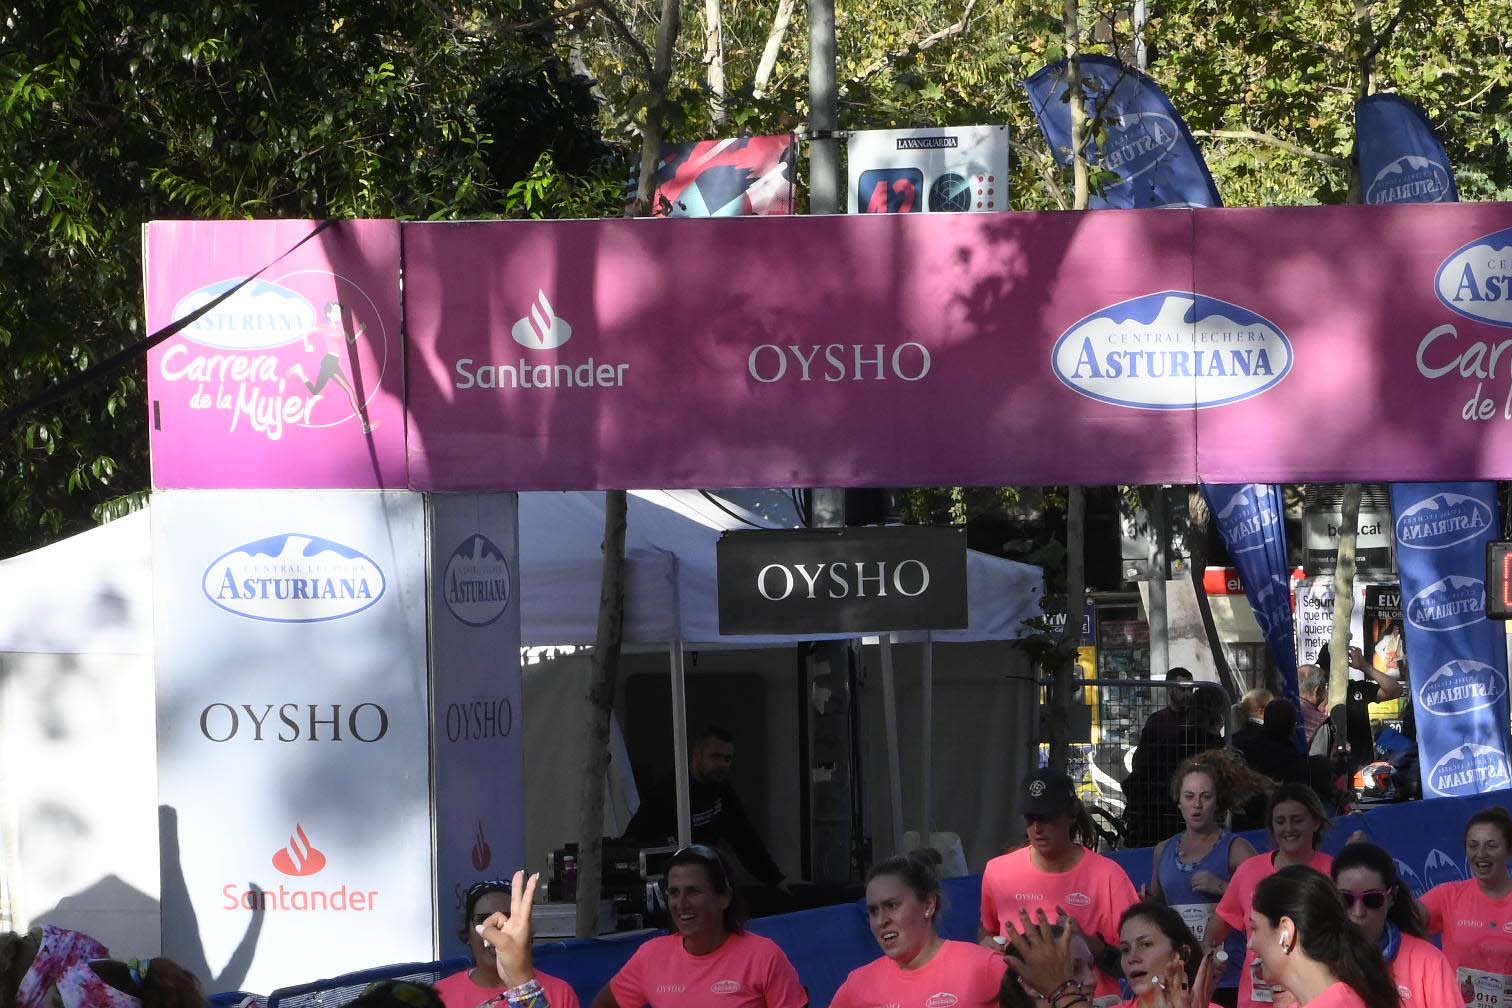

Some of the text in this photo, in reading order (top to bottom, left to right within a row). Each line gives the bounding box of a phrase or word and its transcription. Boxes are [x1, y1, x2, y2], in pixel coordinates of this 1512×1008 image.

[1107, 330, 1267, 345] CENTRAL LECHERA
[161, 344, 279, 383] Carrera
[456, 357, 629, 389] Santander
[747, 341, 932, 382] OYSHO
[1070, 335, 1274, 380] ASTURIANA
[190, 378, 324, 440] de la Mujer
[1462, 383, 1496, 420] de
[217, 567, 372, 600] ASTURIANA
[449, 574, 507, 603] ASTURIANA
[757, 559, 930, 601] OYSHO
[1303, 612, 1319, 621] que
[199, 702, 389, 743] OYSHO
[446, 699, 512, 743] OYSHO
[223, 884, 378, 911] Santander
[1015, 893, 1044, 901] OYSHO
[1476, 992, 1498, 1004] 016
